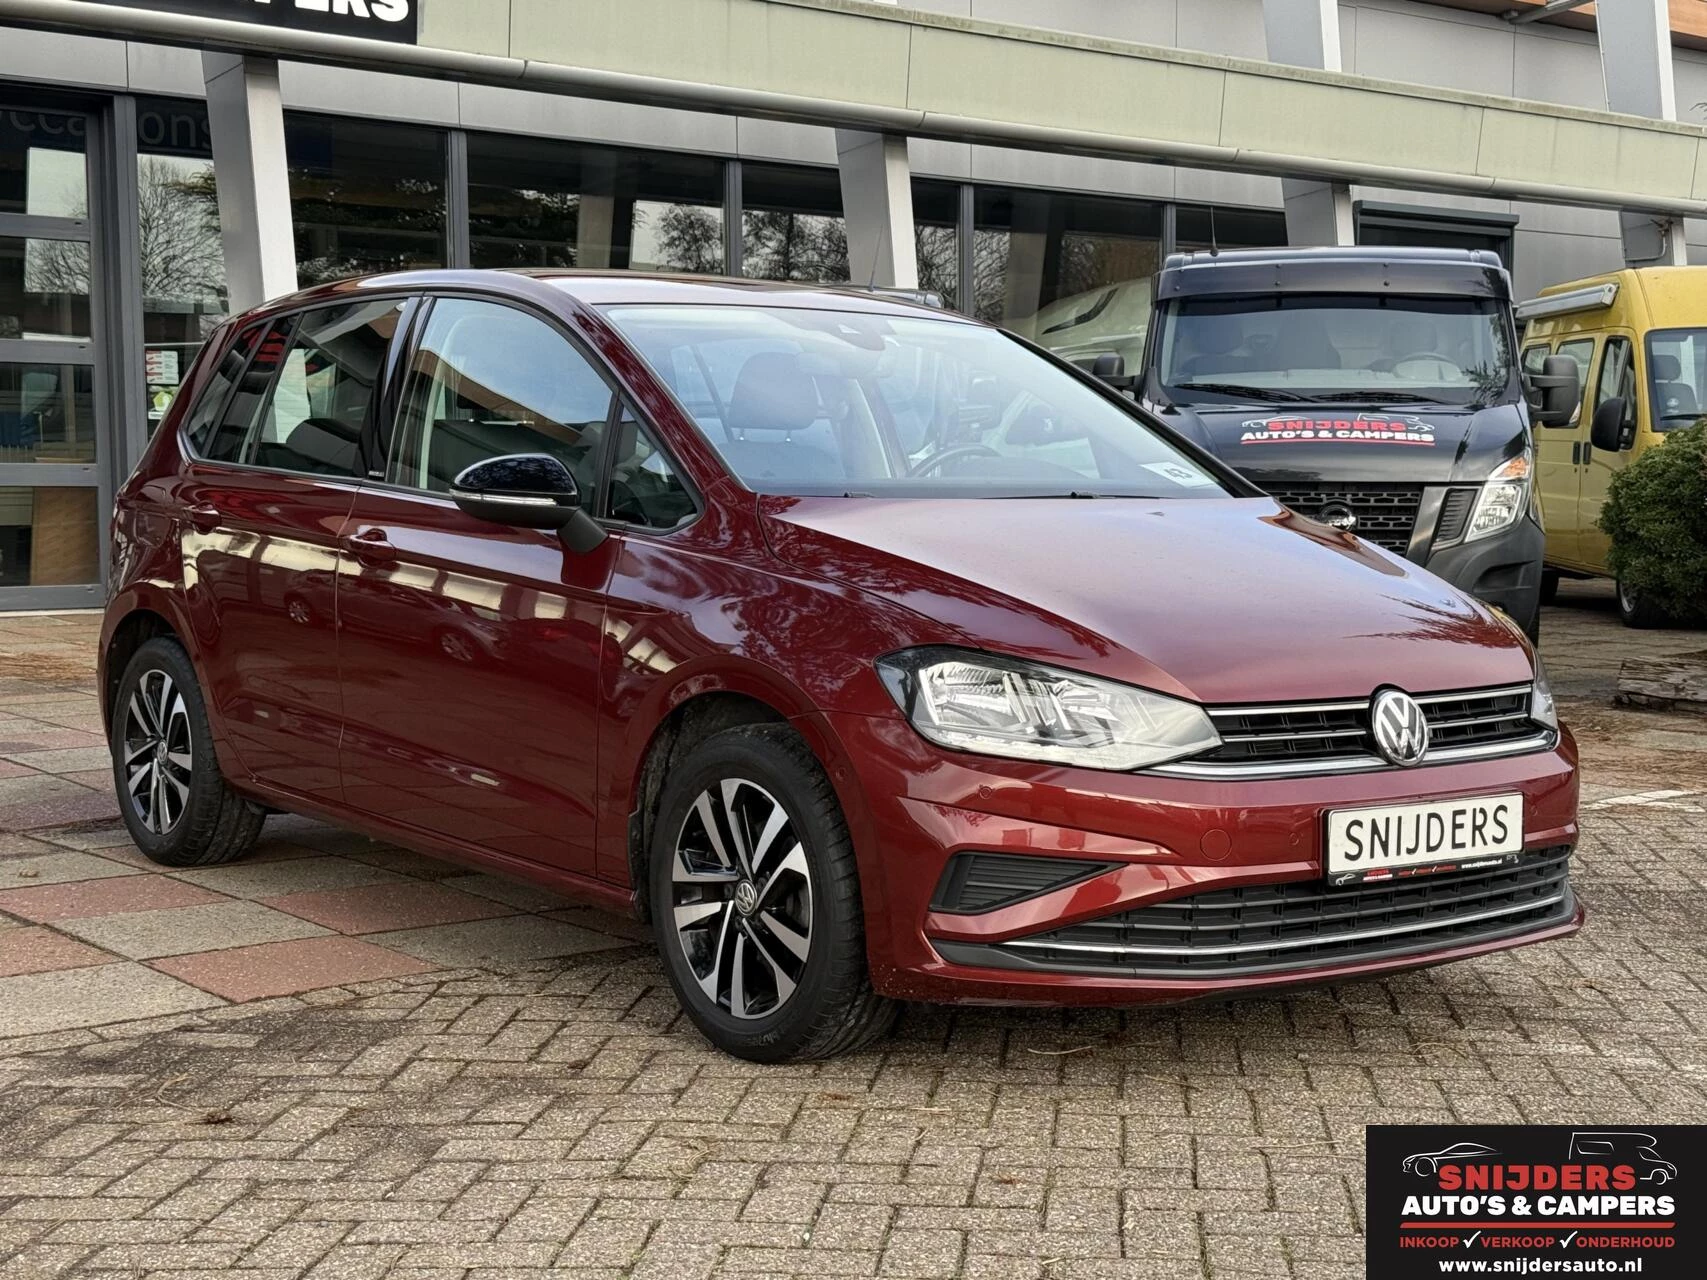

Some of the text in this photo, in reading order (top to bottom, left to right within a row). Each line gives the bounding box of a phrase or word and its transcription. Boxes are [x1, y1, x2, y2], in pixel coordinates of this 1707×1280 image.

[1268, 420, 1407, 431] SNIJDERS
[1241, 430, 1435, 442] AUTO'S & CAMPERS
[1344, 804, 1508, 861] SNIJDERS
